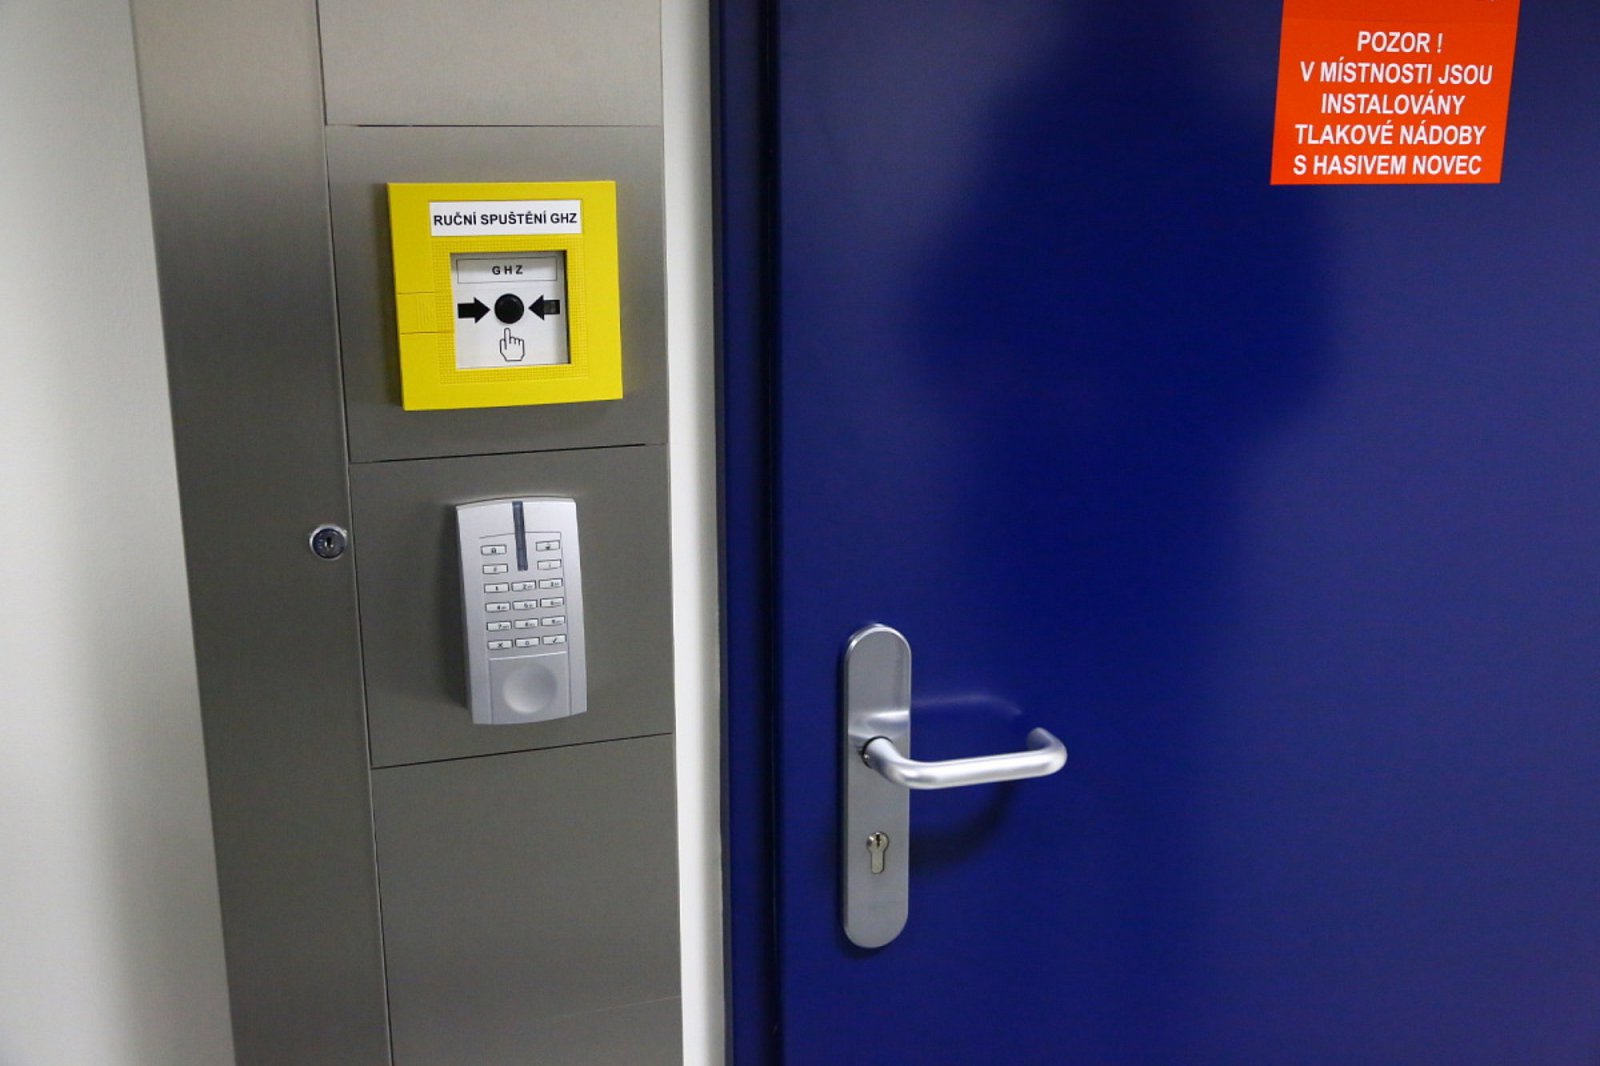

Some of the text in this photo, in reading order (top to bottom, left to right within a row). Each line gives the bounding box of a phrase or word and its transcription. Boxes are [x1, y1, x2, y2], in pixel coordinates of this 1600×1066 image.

[1357, 31, 1443, 53] POZOR !
[1300, 56, 1493, 85] V MÍSTNOSTI JSOU
[1321, 89, 1466, 115] INSTALOVÁNY
[1295, 119, 1487, 145] TLAKOVÉ NÁDOBY
[1293, 154, 1483, 176] S HASIVEM NOVEC
[433, 210, 578, 226] RUČNÍ SPUŠTĚNÍ GHZ
